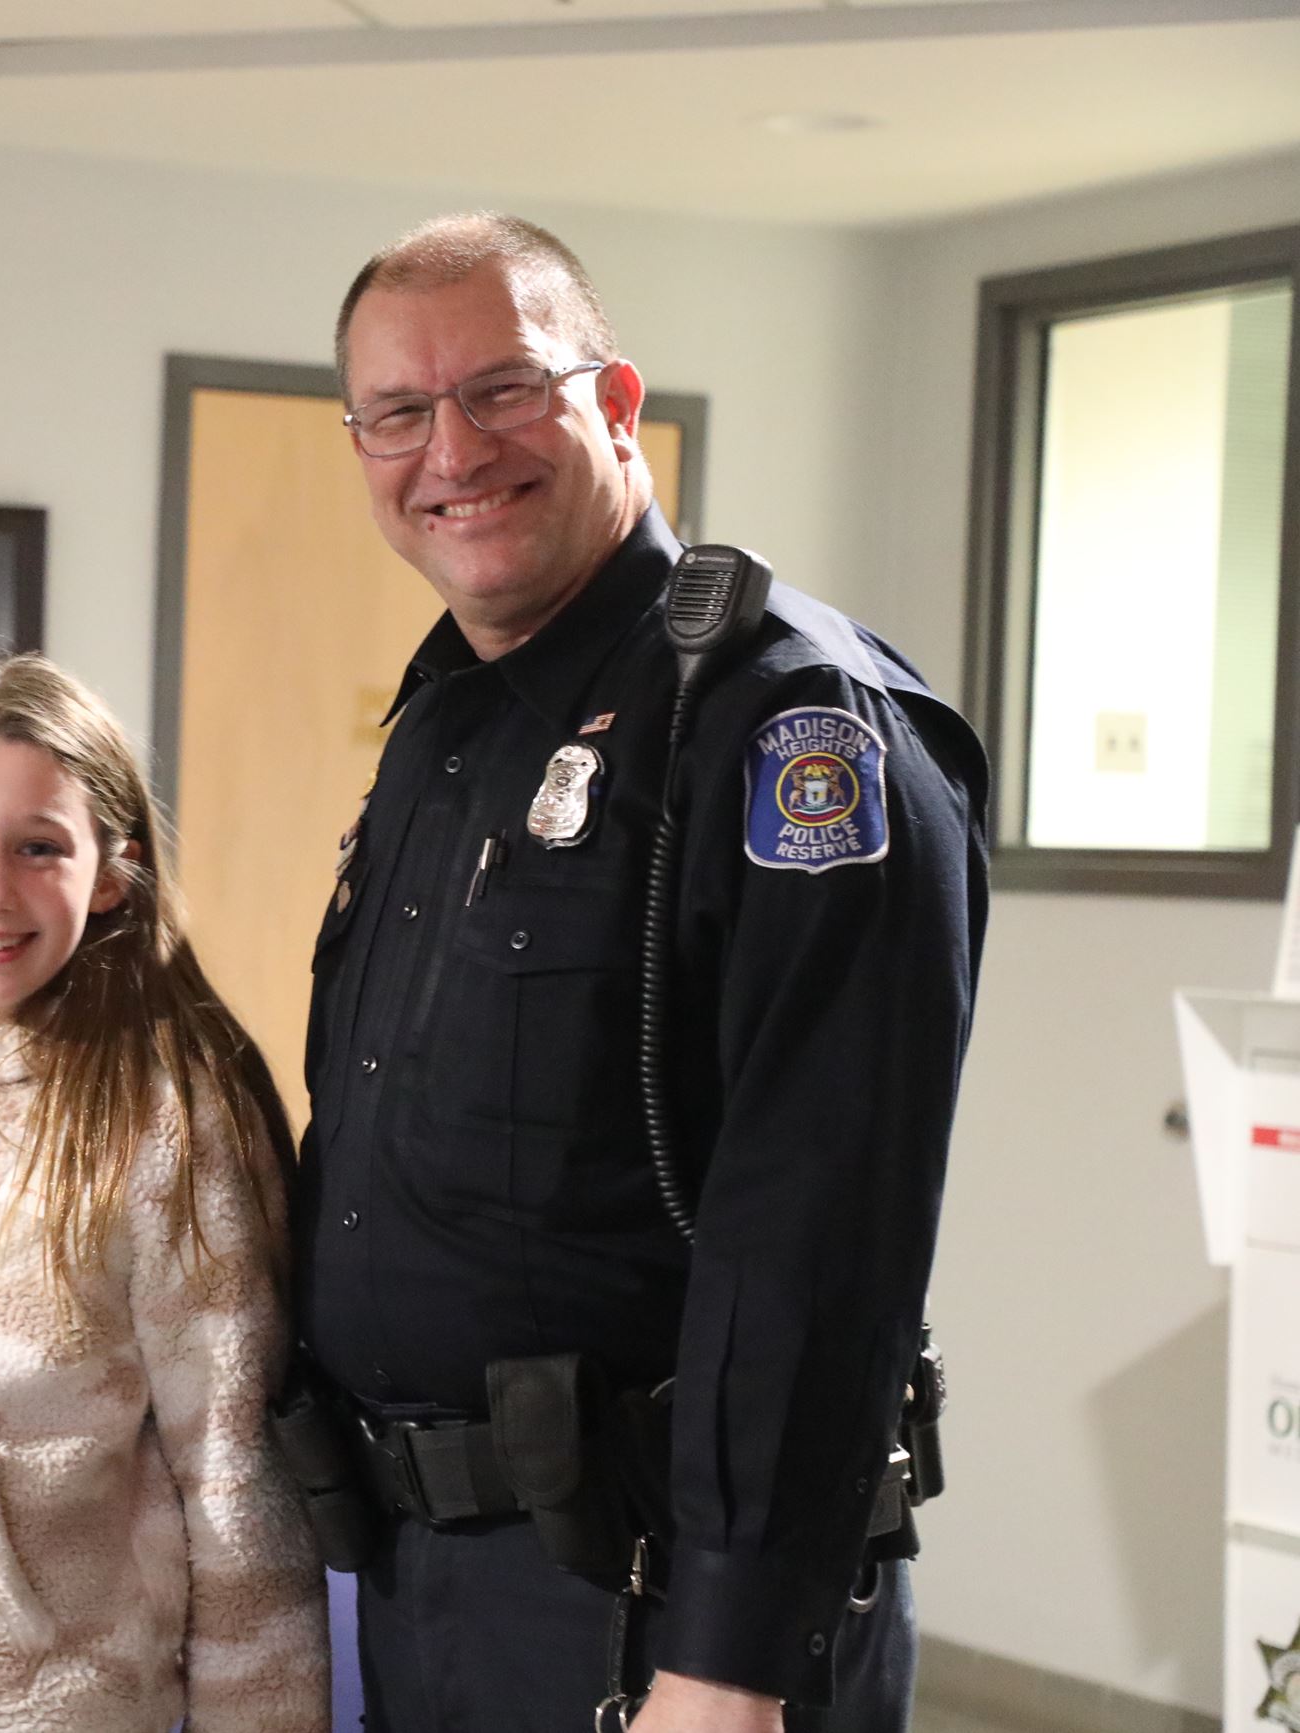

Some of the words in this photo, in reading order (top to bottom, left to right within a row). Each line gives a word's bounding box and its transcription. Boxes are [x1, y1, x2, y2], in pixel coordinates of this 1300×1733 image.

[757, 717, 871, 756] MADISON
[776, 738, 859, 761] HEIGHTS
[778, 817, 860, 844] POLICE
[775, 837, 862, 860] RESERVE
